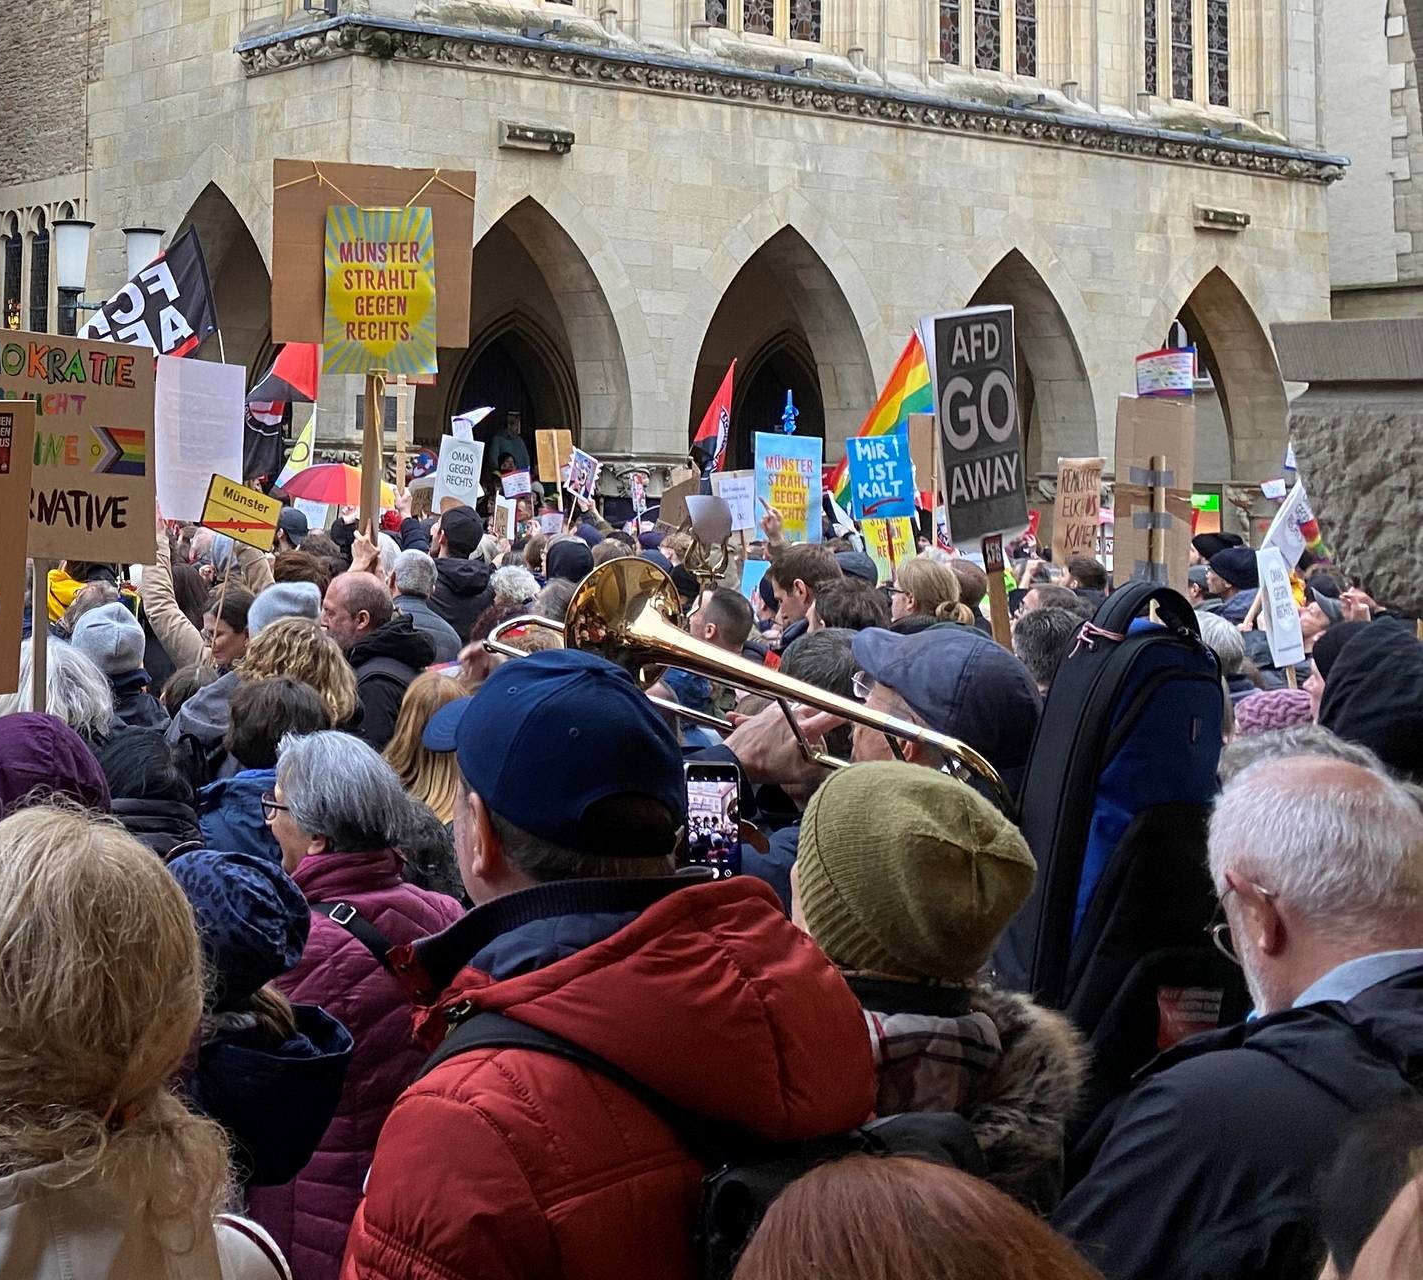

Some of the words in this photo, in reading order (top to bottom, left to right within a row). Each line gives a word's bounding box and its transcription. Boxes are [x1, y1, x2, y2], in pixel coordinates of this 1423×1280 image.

[339, 237, 420, 264] MÜNSTER
[344, 269, 418, 290] STRAHLT
[355, 295, 407, 316] GEGEN
[345, 321, 414, 341] RECHTS.
[951, 322, 1000, 366] AFD
[941, 370, 1015, 450] GO
[33, 432, 80, 467] INE
[451, 450, 475, 464] OMAS
[448, 462, 474, 476] GEGEN
[765, 454, 813, 473] MÜNSTER
[445, 474, 473, 488] RECHTS
[768, 473, 811, 489] STRAHLT
[951, 453, 1018, 505] AWAY
[222, 486, 270, 514] Münster
[774, 490, 806, 504] GEGEN
[857, 480, 903, 500] KALT
